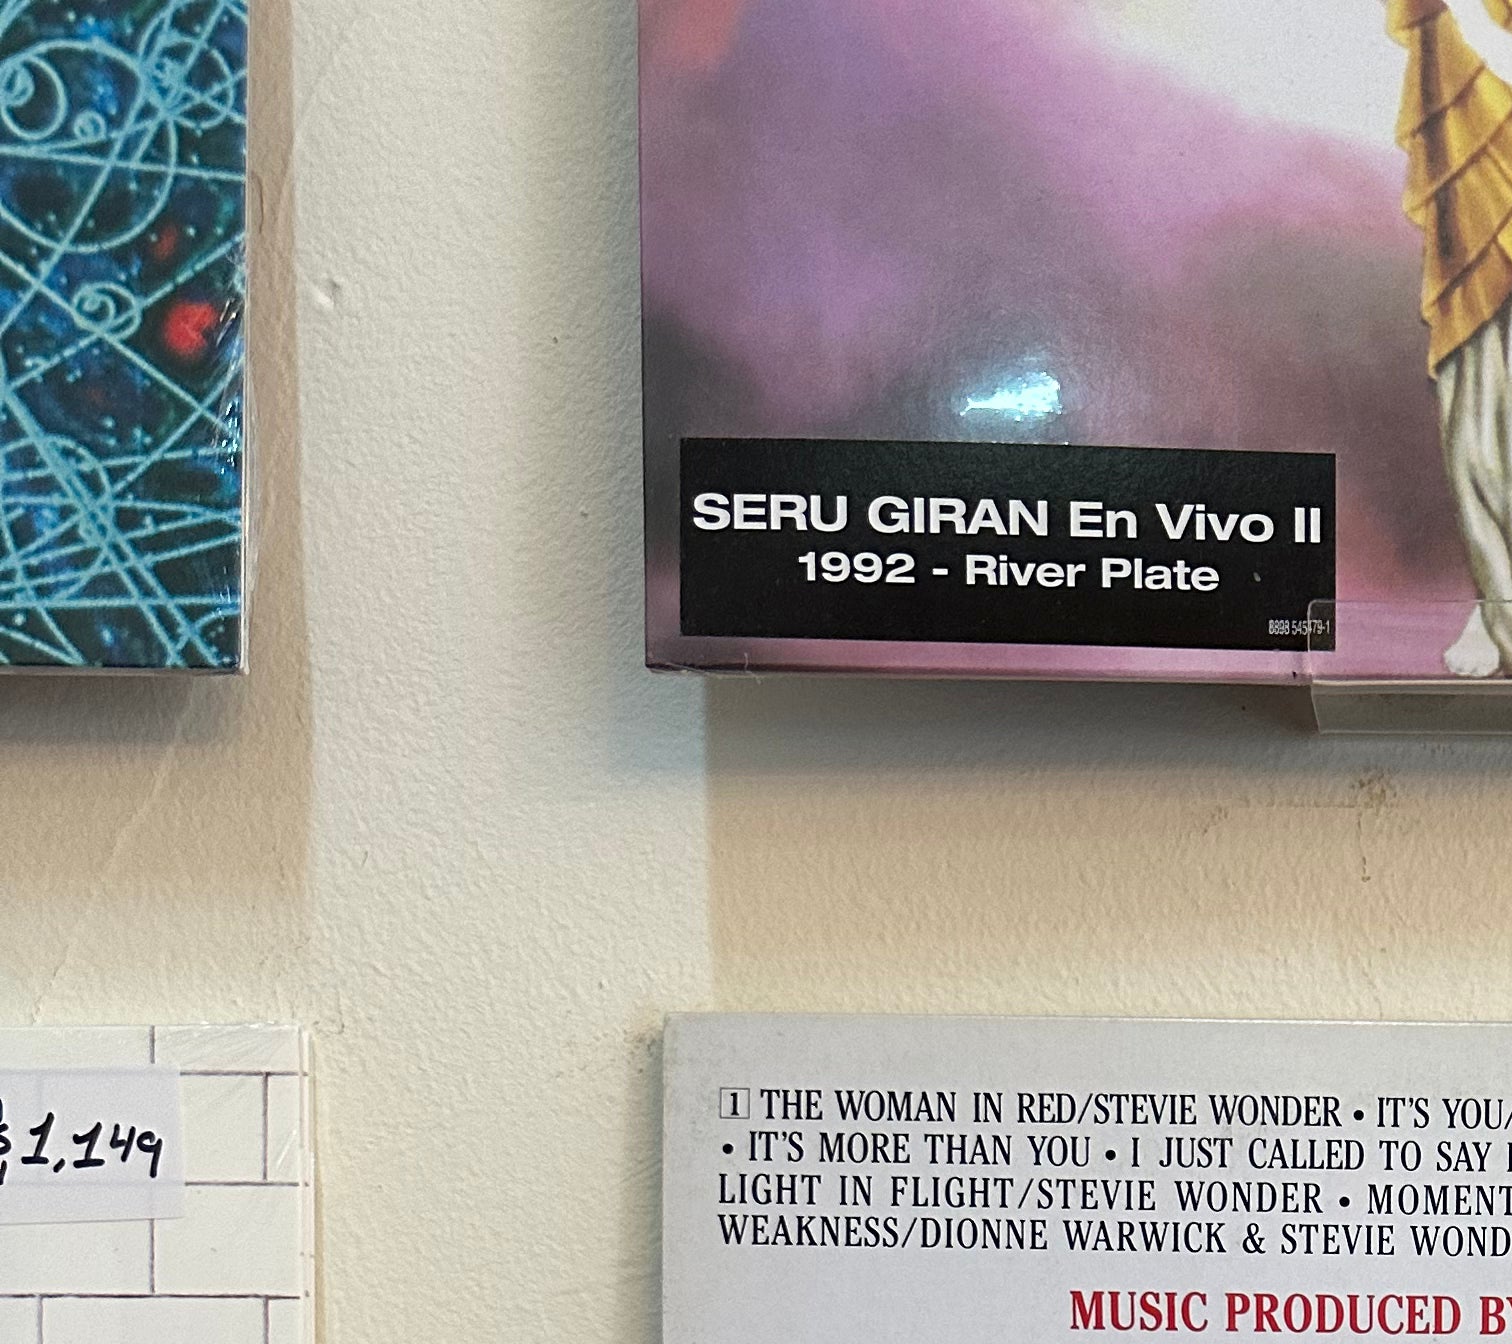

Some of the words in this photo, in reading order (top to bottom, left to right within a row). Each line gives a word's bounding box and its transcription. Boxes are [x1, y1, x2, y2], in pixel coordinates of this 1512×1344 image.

[694, 493, 847, 531] SERU
[868, 496, 1047, 535] GIRAN
[1070, 501, 1137, 538] En
[1155, 504, 1273, 542] Vivo
[1295, 508, 1320, 542] II
[799, 552, 914, 583] 1992
[967, 555, 1085, 587] River
[1102, 558, 1219, 590] Plate
[761, 1089, 822, 1120] THE
[835, 1090, 956, 1122] WOMAN
[974, 1093, 1002, 1122] IN
[1018, 1093, 1196, 1124] RED/STEVIE
[1209, 1095, 1342, 1126] WONDER
[1378, 1097, 1429, 1128] IT'S
[749, 1131, 803, 1162] IT'S
[819, 1133, 910, 1163] MORE
[924, 1134, 1011, 1165] THAN
[1027, 1136, 1090, 1166] YOU
[1132, 1138, 1139, 1167] I
[1159, 1137, 1232, 1168] JUST
[1249, 1138, 1364, 1169] CALLED
[1379, 1140, 1421, 1171] TO
[1437, 1141, 1492, 1172] SAY
[719, 1174, 821, 1204] LIGHT
[840, 1176, 872, 1206] IN
[891, 1176, 1155, 1210] FLIGHT/STEVIE
[1175, 1181, 1323, 1213] WONDER
[718, 1214, 1047, 1249] WEAKNESS/DIONNE
[1063, 1220, 1226, 1252] WARWICK
[1243, 1223, 1265, 1254] &
[1282, 1224, 1394, 1255] STEVIE
[1072, 1291, 1206, 1330] MUSIC
[1228, 1294, 1460, 1334] PRODUCED
